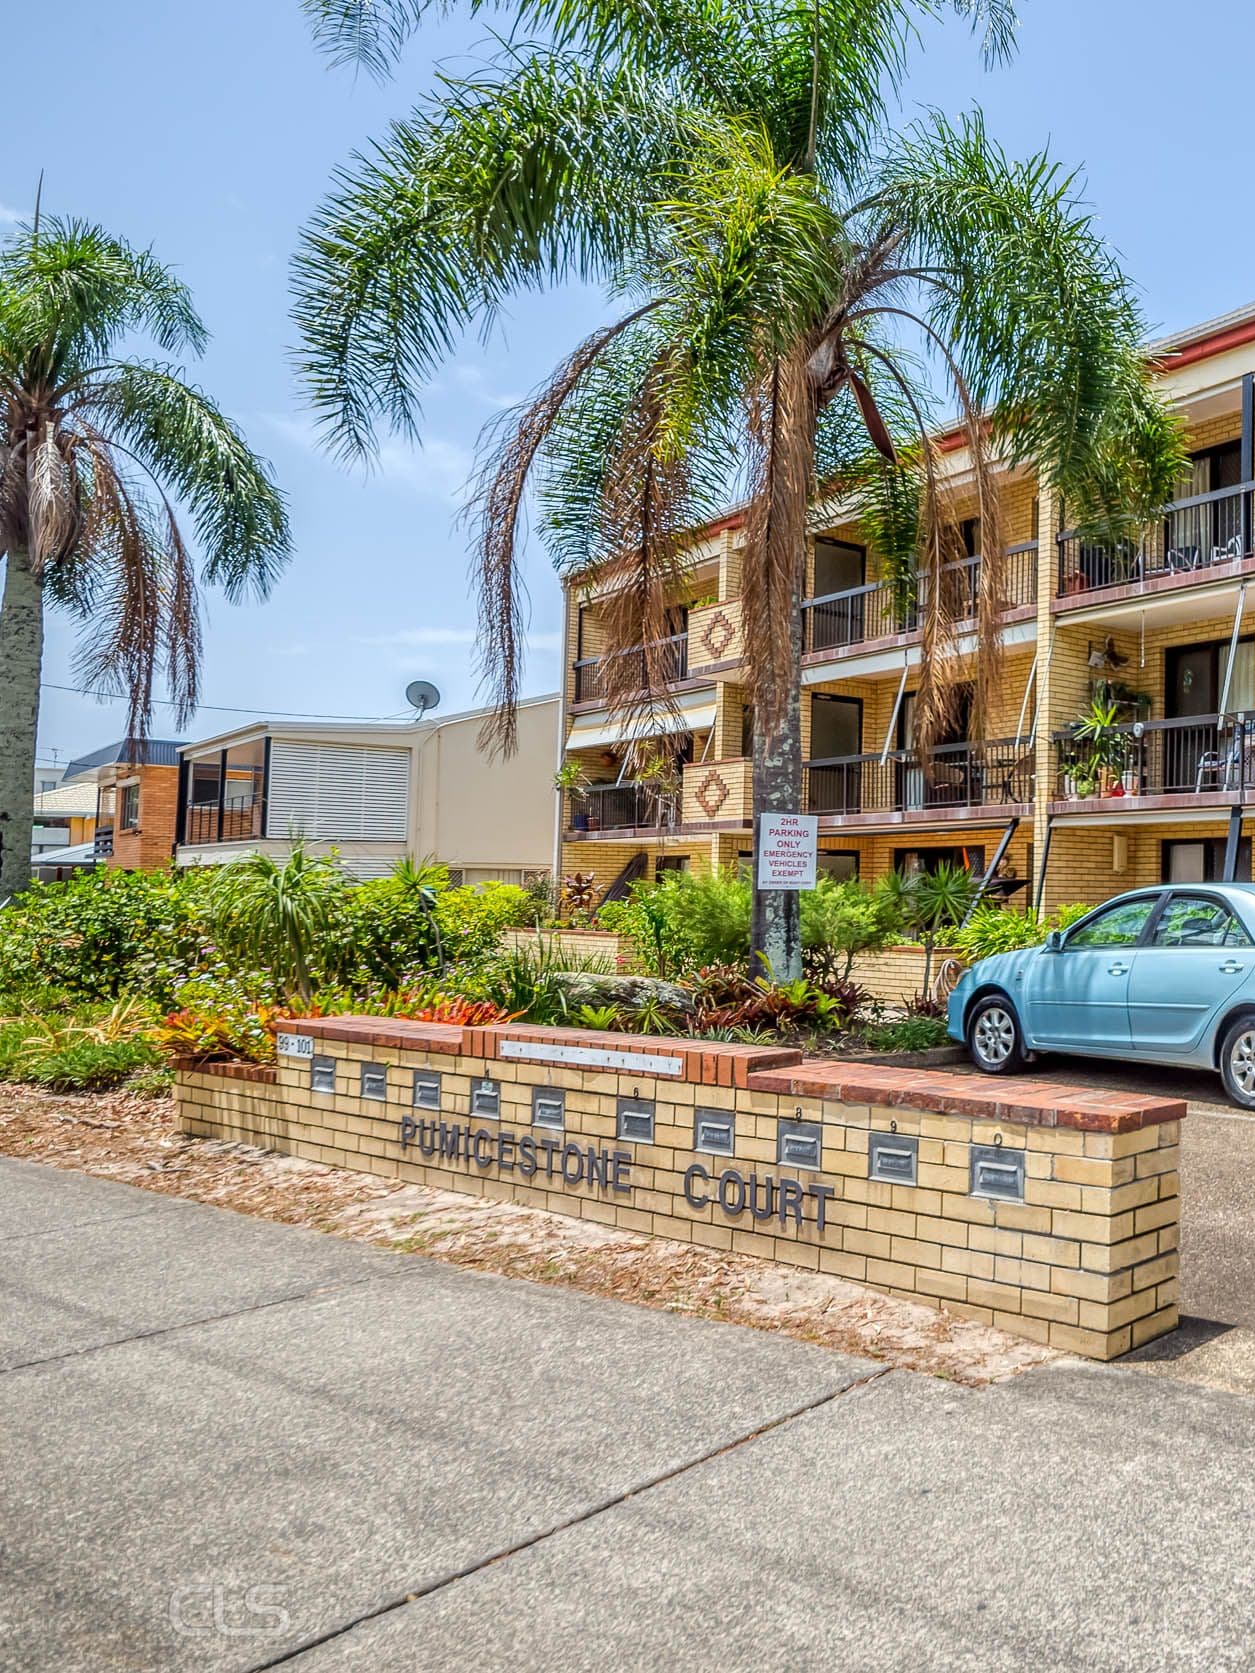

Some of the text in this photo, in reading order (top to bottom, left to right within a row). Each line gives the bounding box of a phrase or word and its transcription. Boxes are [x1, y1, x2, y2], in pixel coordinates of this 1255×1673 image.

[780, 818, 799, 826] 2HR
[769, 829, 809, 837] PARKING
[776, 840, 800, 848] ONLY
[763, 850, 814, 858] EMERGENCY
[769, 860, 807, 868] VEHICLES
[278, 1036, 289, 1051] 99
[297, 1039, 311, 1054] 101
[890, 1120, 897, 1133] 9
[401, 1115, 835, 1232] PUMICESTONE COURT
